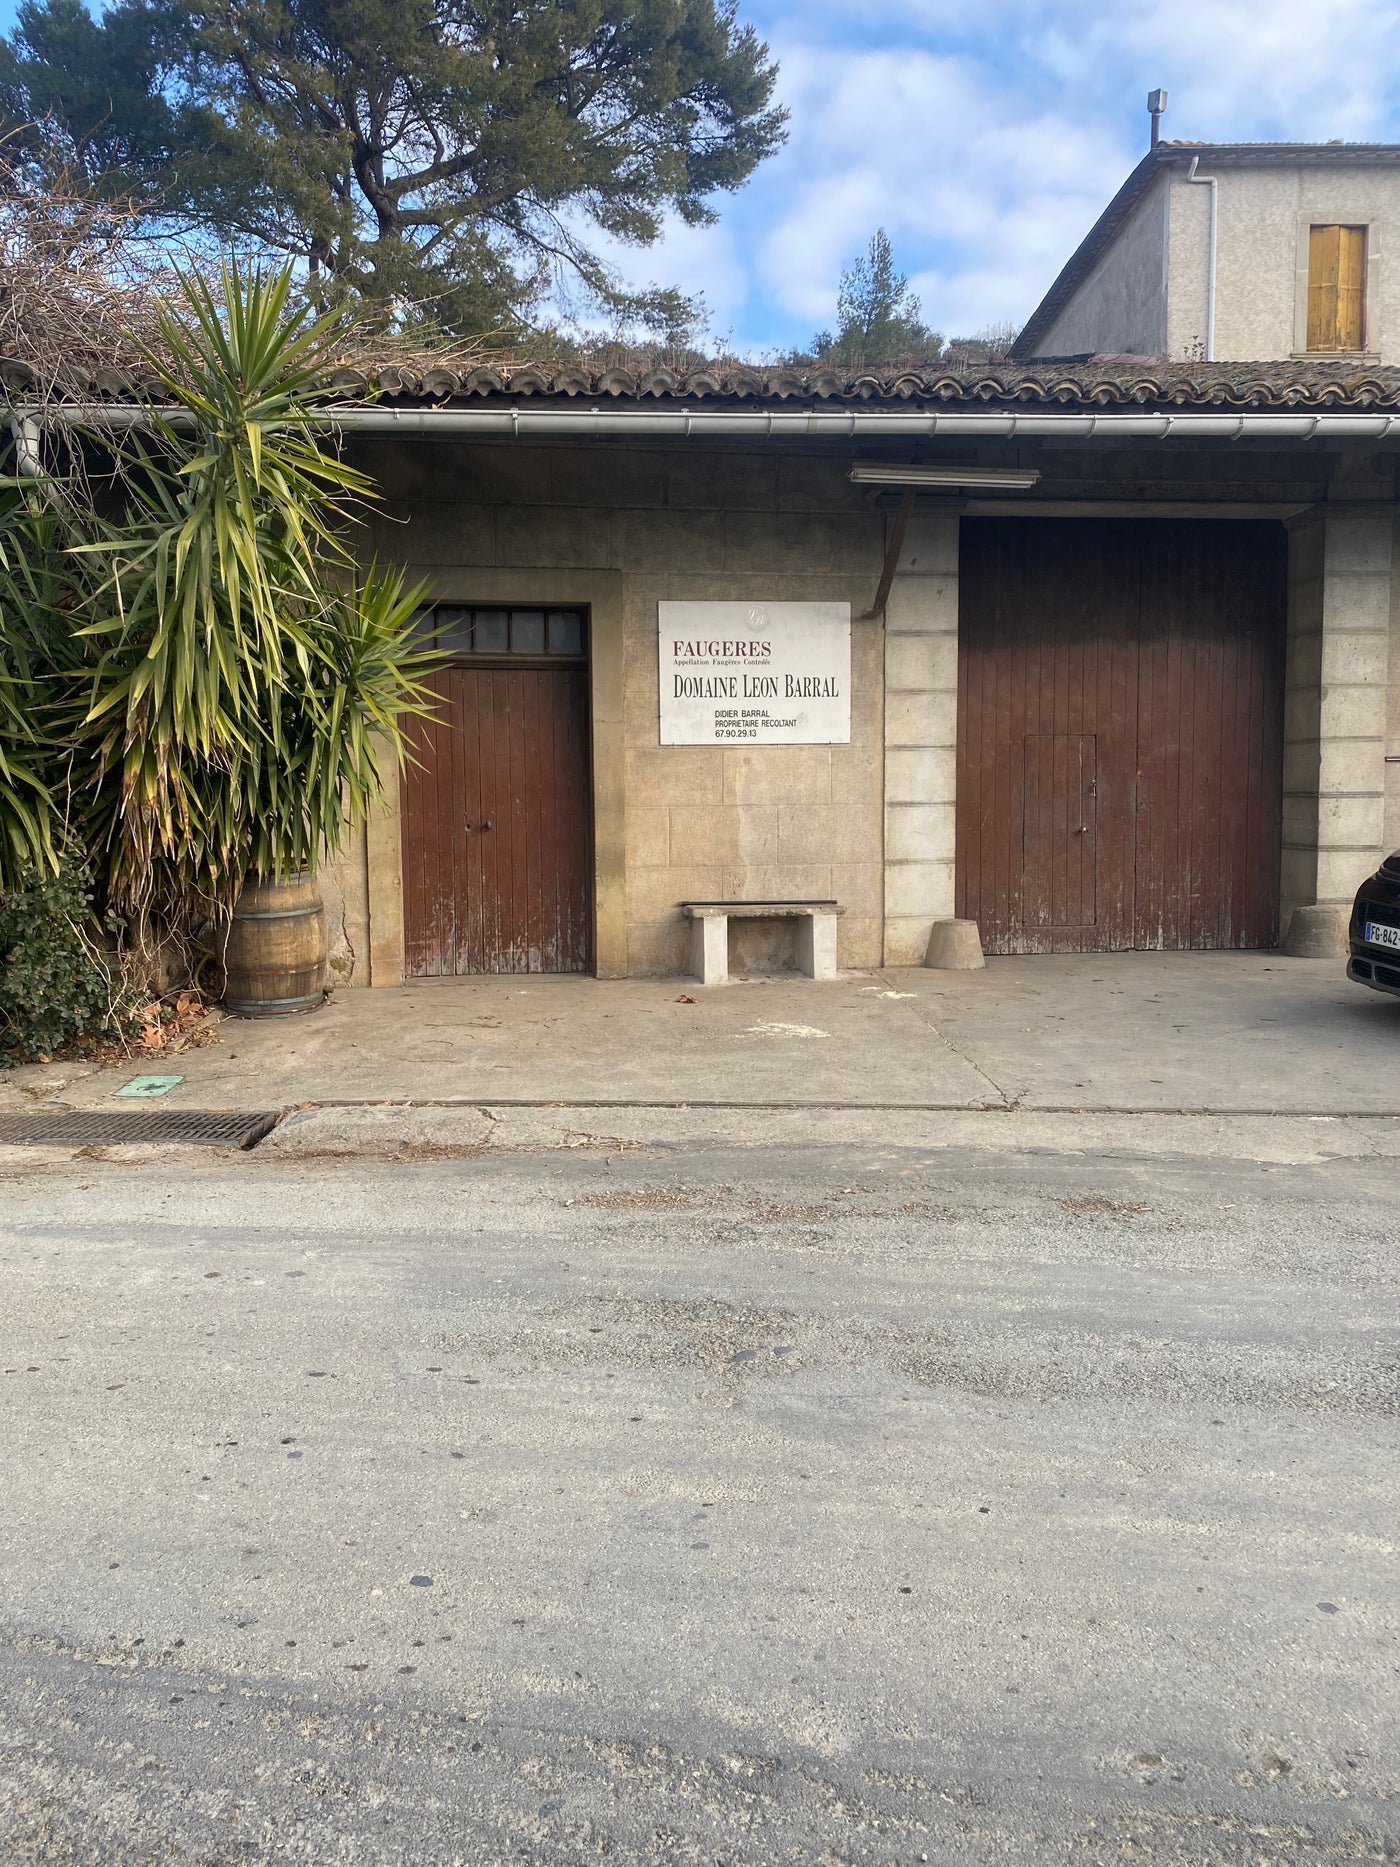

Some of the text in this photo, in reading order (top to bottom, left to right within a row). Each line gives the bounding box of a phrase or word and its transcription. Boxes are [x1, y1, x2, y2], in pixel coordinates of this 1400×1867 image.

[673, 640, 772, 657] FAUGERES
[673, 658, 709, 667] Appellation
[674, 674, 839, 698] DOMAINE LEON BARRAL
[715, 710, 770, 718] DIDIER BARRAL
[715, 719, 797, 728] PROPRIETAIRE RECOLTANT
[715, 729, 757, 738] 67.90.29.13
